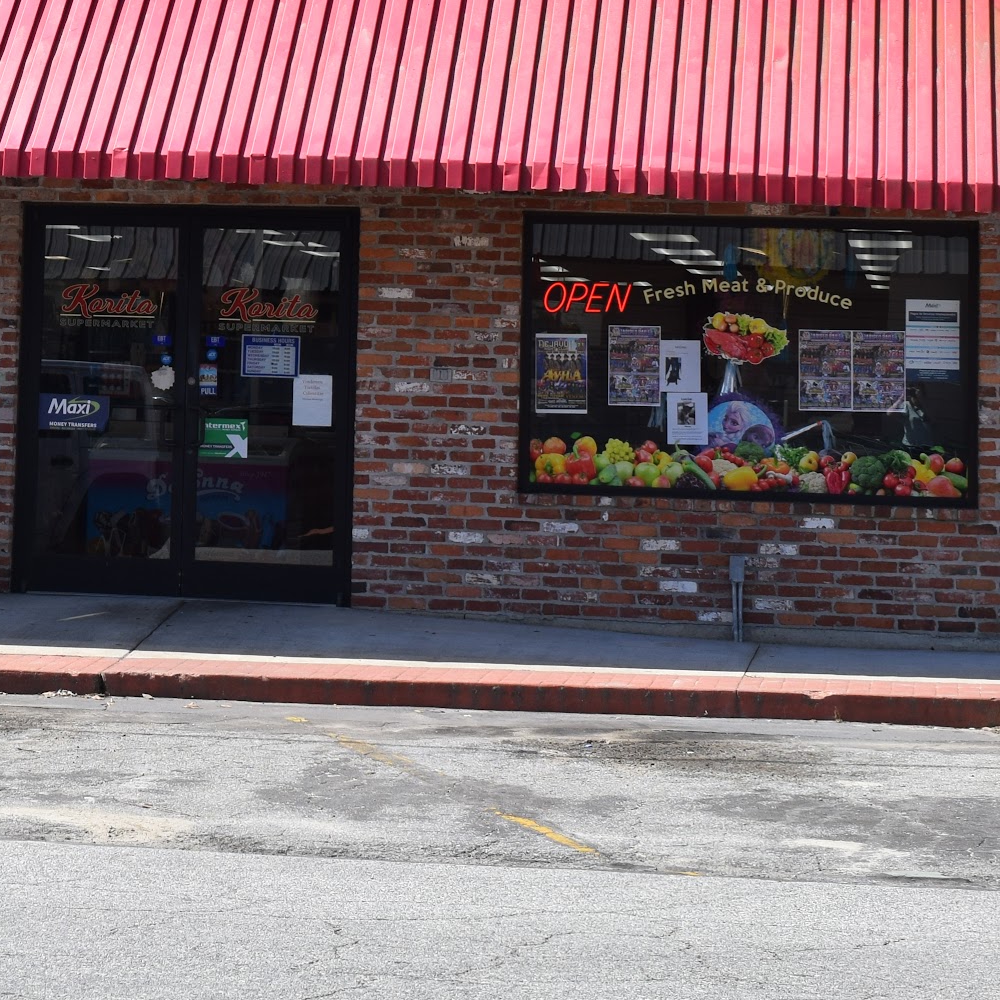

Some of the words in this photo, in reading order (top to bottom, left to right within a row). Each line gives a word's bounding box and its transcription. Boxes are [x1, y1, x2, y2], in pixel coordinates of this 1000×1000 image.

[61, 283, 158, 319] Korita
[220, 287, 318, 323] Korita
[543, 282, 632, 313] OPEN
[643, 280, 696, 305] Fresh
[702, 278, 749, 294] Meat
[755, 278, 768, 293] &
[775, 279, 853, 310] Produce
[59, 318, 155, 329] SUPERMARKET
[218, 323, 315, 333] SUPERMARKET
[200, 387, 216, 395] PULL
[47, 398, 91, 415] Maxi
